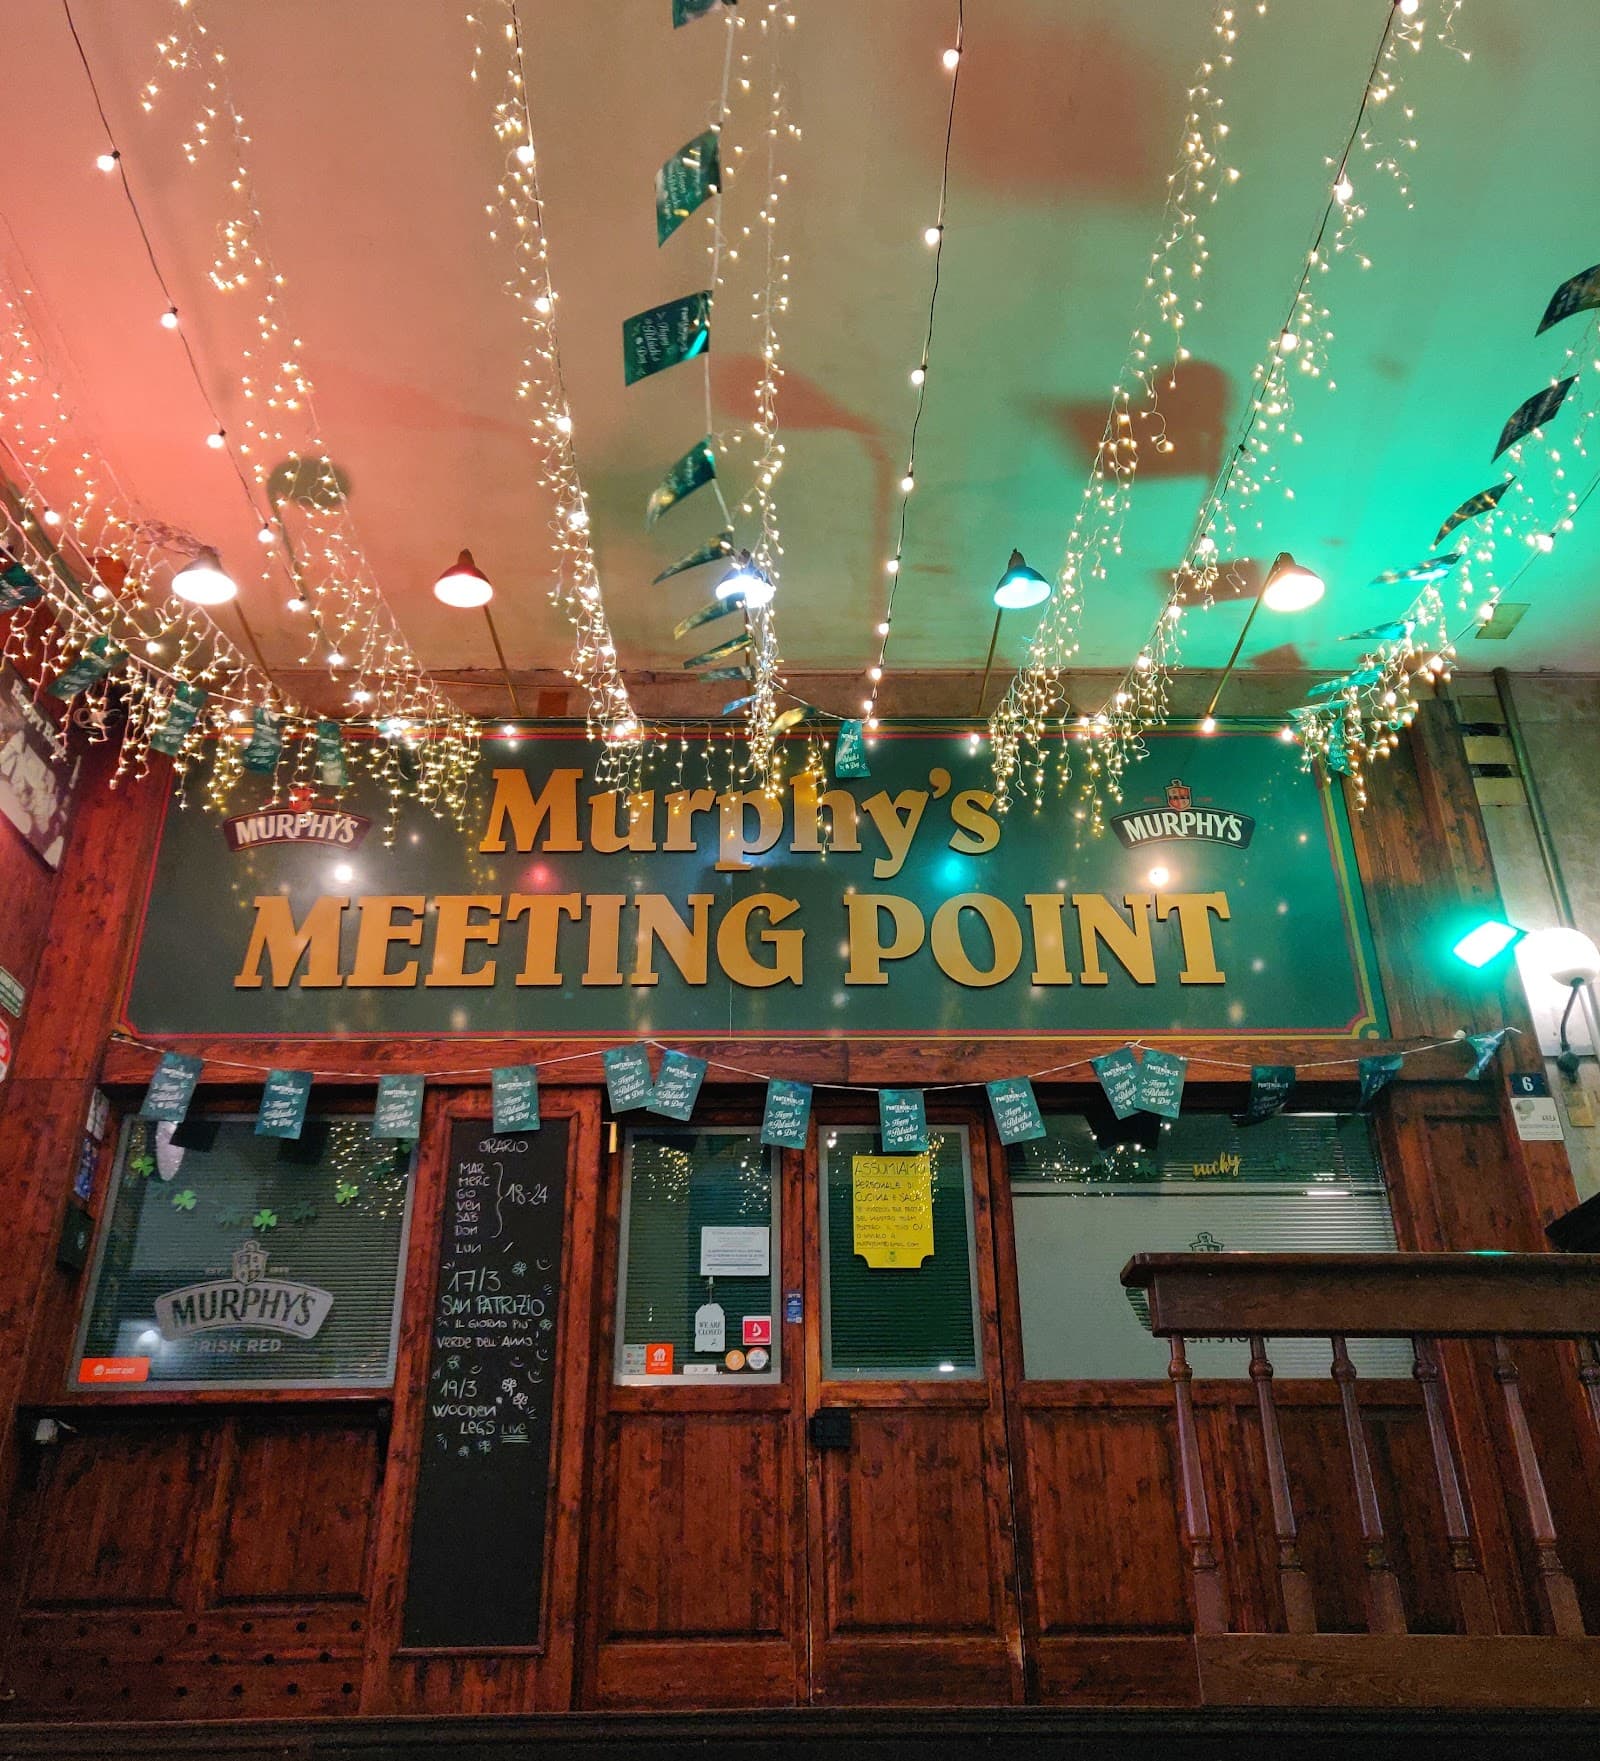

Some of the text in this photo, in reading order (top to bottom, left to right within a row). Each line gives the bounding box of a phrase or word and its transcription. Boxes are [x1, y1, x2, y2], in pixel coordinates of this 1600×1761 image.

[235, 813, 359, 845] MURPHY'S
[479, 768, 1001, 879] Murphy's
[1122, 812, 1242, 842] MURPHY'S
[234, 892, 1231, 987] MEETING POINT
[1522, 1076, 1534, 1091] 6
[479, 1138, 529, 1153] ORARIO
[460, 1163, 485, 1175] MAR
[505, 1184, 548, 1205] 18-24
[456, 1212, 478, 1223] SAB
[455, 1225, 478, 1236] DOM
[456, 1243, 481, 1254] LUN
[447, 1266, 501, 1292] 17/3
[172, 1287, 315, 1327] MURPHY'S
[442, 1295, 545, 1316] SAN PATRIZIO
[455, 1319, 465, 1328] IL
[468, 1319, 507, 1328] GIORNO
[247, 1339, 281, 1352] RED
[440, 1378, 477, 1399] 19/3
